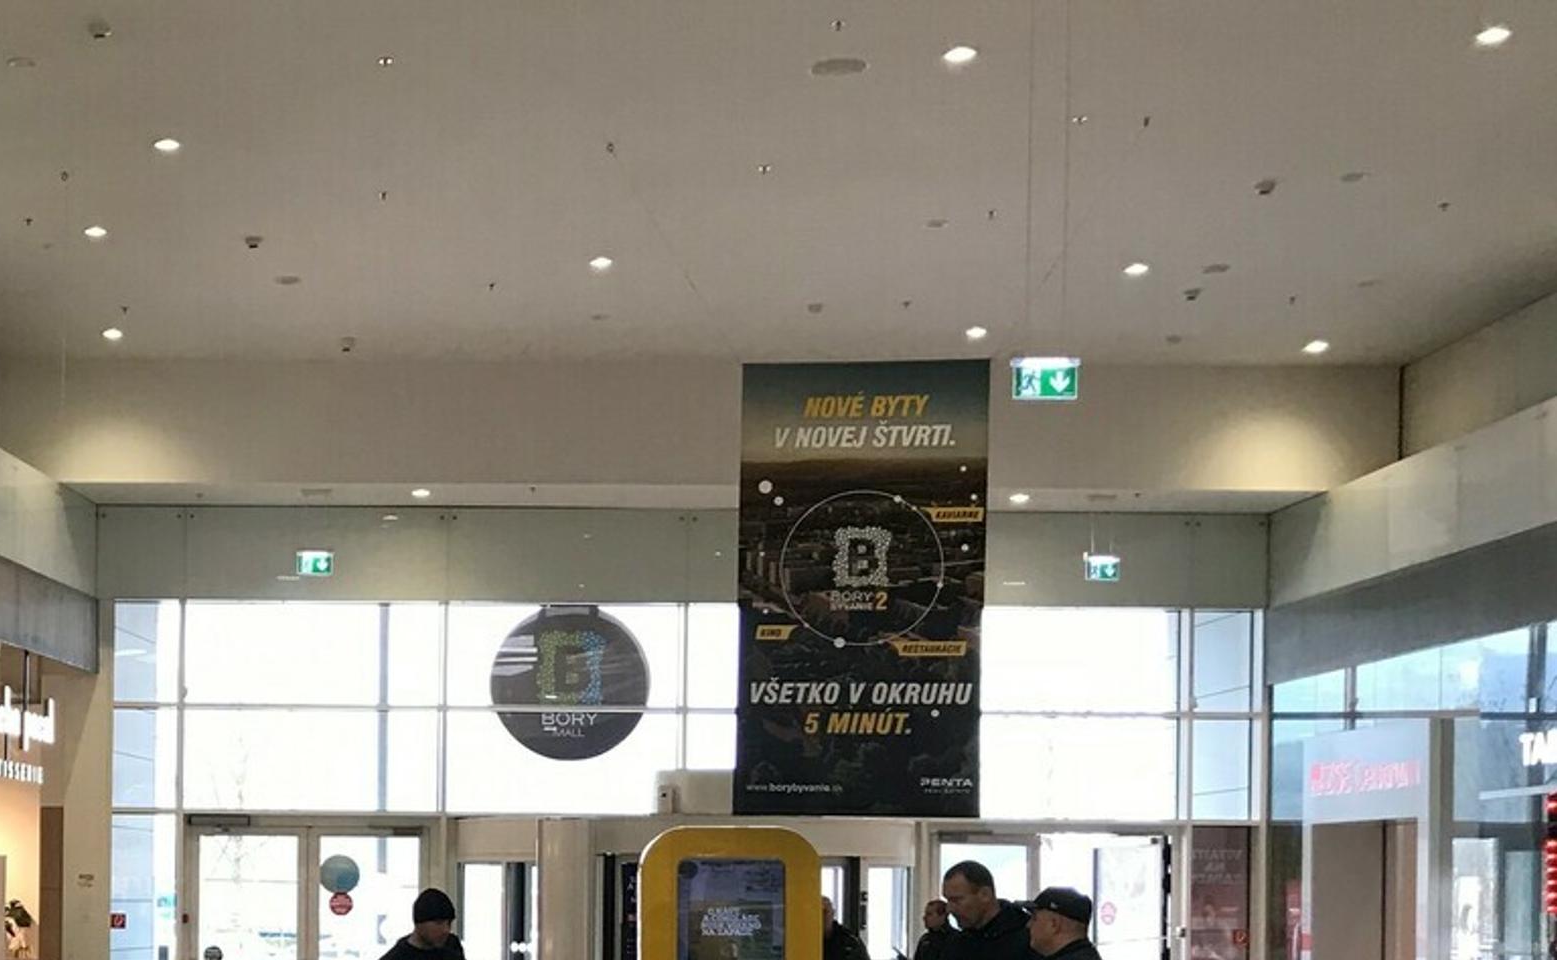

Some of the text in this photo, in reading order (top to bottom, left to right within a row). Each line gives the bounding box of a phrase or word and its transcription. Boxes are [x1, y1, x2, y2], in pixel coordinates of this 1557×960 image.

[805, 390, 931, 418] NOVÉ BYTY
[775, 420, 956, 449] V NOVEJ ŠTVRTI.
[875, 591, 888, 611] 2
[749, 676, 973, 706] VŠETKO V OKRUHU
[541, 712, 598, 726] BORY
[804, 707, 913, 735] 5 MINÚT.
